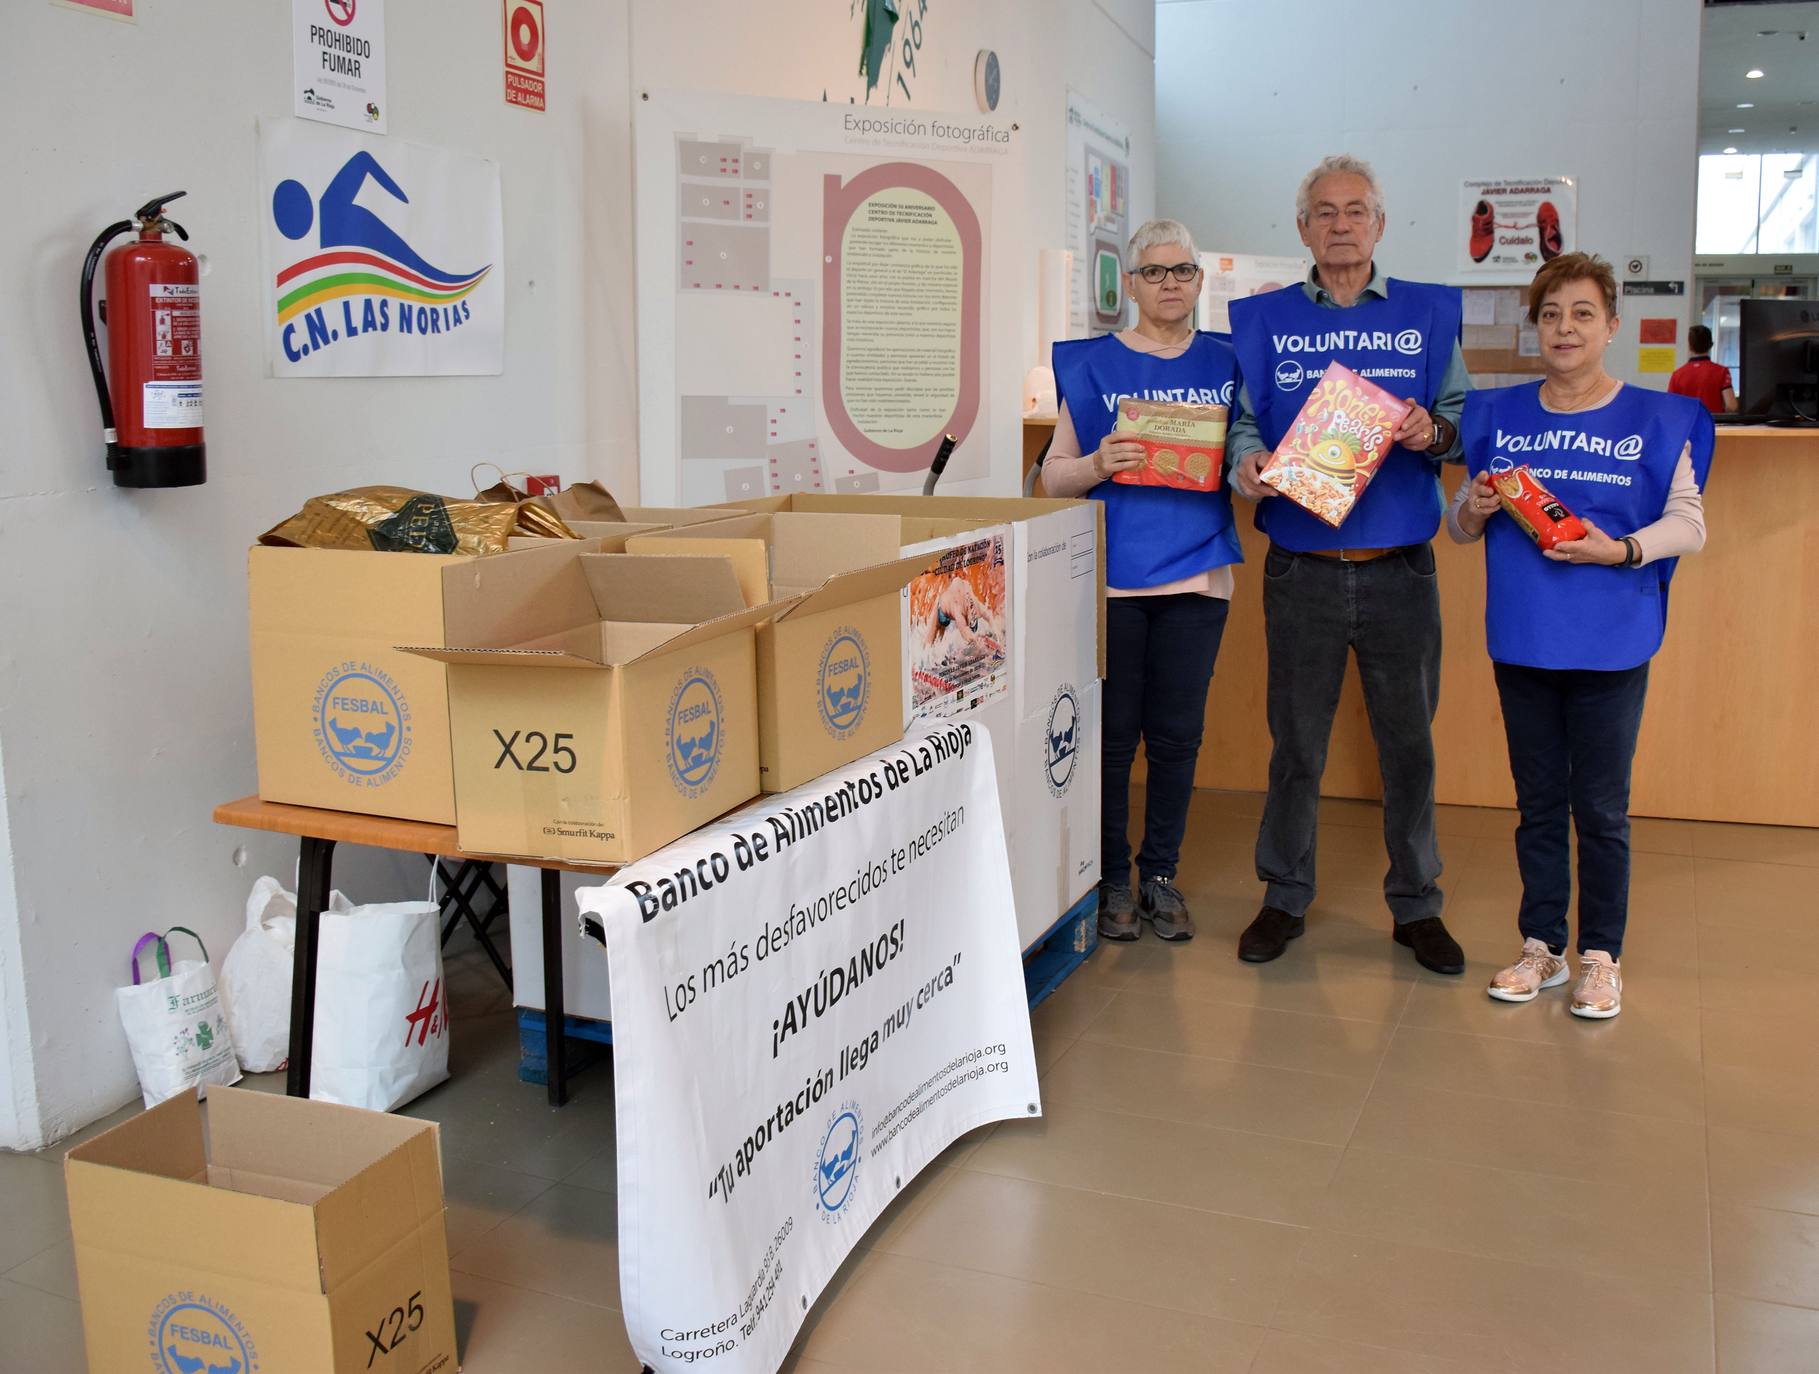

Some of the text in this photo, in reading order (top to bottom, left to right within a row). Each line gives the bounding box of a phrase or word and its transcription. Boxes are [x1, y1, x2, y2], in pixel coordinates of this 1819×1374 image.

[310, 24, 370, 59] PROHIBIDO
[322, 51, 361, 78] FUMAR
[507, 74, 543, 94] PULSADOR
[507, 89, 544, 108] DE ALARMA
[844, 113, 1010, 146] Exposición fotográfica
[1509, 186, 1552, 195] ADARRAGA
[282, 298, 470, 363] C.N. LAS NORIAS
[1272, 329, 1423, 355] VOLUNTARI@
[1360, 369, 1416, 378] ALIMENTOS
[1154, 425, 1186, 434] DORADA
[1169, 419, 1196, 428] MARÍA
[1495, 428, 1643, 461] VOLUNTARI@
[1554, 468, 1567, 479] DE
[1570, 470, 1632, 486] ALIMENTOS
[828, 656, 859, 678] FESBAL
[312, 661, 412, 721] BANCOS DE ALIMENTOS
[333, 697, 389, 715] FESBAL
[677, 699, 711, 726] FESBAL
[313, 728, 413, 788] BANCOS DE ALIMENTOS
[492, 728, 577, 774] X25
[557, 827, 616, 842] Smurfit Kappa
[625, 723, 972, 924] Banco de Alimentos de La Rioja
[663, 806, 965, 1022] Los más desfavorecidos te necesitan
[772, 918, 905, 1060] ¡AYÚDANOS!
[736, 1070, 834, 1177] aportación
[839, 1030, 879, 1081] llega
[881, 1000, 914, 1043] muy
[915, 952, 961, 1010] cerca”
[871, 1042, 1006, 1139] info@bancodealimentosdelarioja.org
[870, 1061, 1009, 1158] www.bancodealimentosdelarioja.org
[148, 1291, 258, 1360] BANCOS DE ALIMENTOS
[170, 1323, 234, 1351] FESBAL
[366, 1290, 425, 1369] X25
[660, 1312, 738, 1342] Carretera
[661, 1338, 739, 1364] Logroño.
